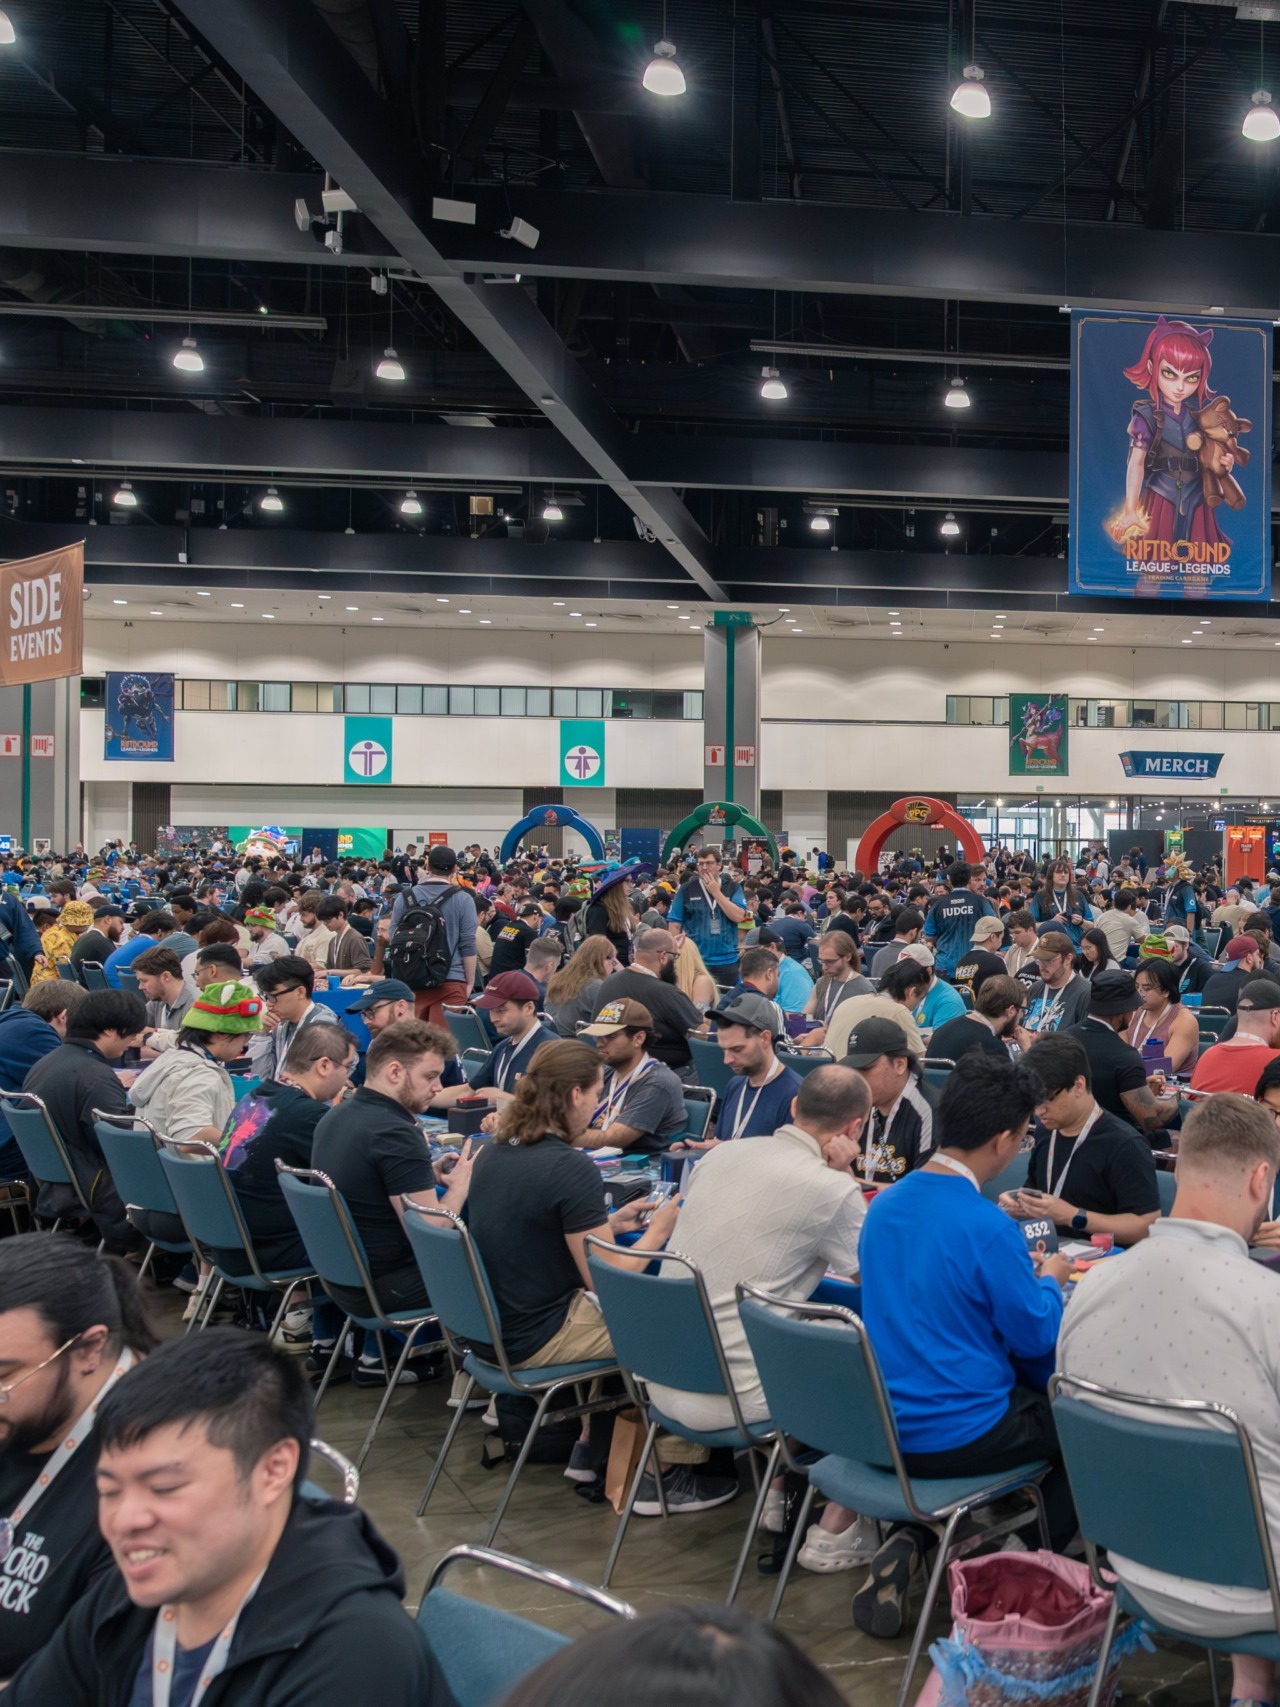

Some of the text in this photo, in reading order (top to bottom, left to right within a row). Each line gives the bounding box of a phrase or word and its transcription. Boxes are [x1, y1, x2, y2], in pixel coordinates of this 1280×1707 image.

[1126, 540, 1231, 563] RIFTBOUND
[1126, 561, 1171, 573] LEAGUE
[1180, 563, 1231, 575] LEGENDS
[10, 573, 62, 629] SIDE
[10, 626, 62, 662] EVENTS
[1145, 758, 1209, 774] MERCH
[909, 809, 927, 818] PPG
[943, 905, 974, 918] JUDGE
[1025, 1221, 1051, 1239] 832
[23, 1532, 45, 1551] THE
[0, 1545, 50, 1585] ORO
